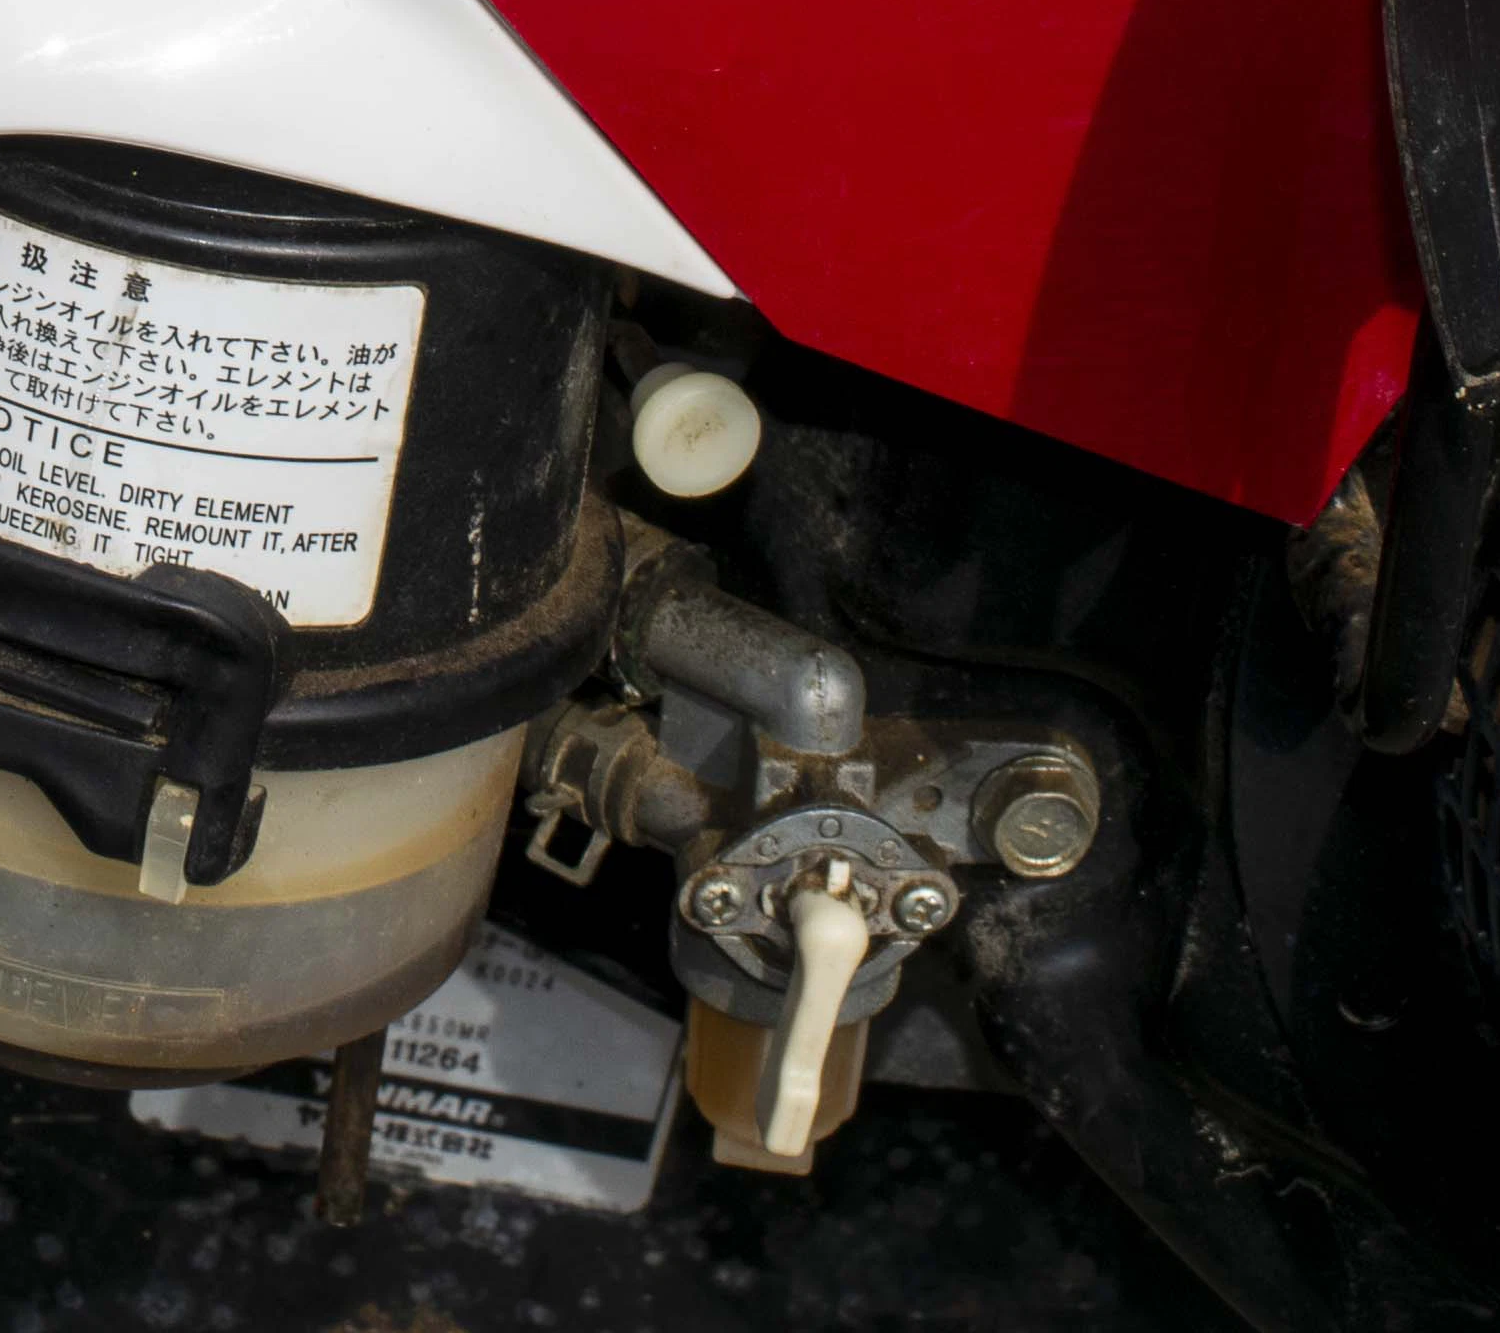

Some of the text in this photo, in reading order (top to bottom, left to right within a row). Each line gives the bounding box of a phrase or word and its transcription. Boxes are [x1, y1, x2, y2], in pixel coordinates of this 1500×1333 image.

[16, 482, 131, 532] KEROSENE.
[145, 516, 252, 550] REMOUNT
[262, 531, 285, 554] IT,
[292, 532, 358, 553] AFTER
[39, 461, 106, 498] LEVEL.
[119, 482, 183, 512] DIRTY
[194, 497, 294, 525] ELEMENT
[93, 533, 112, 554] IT
